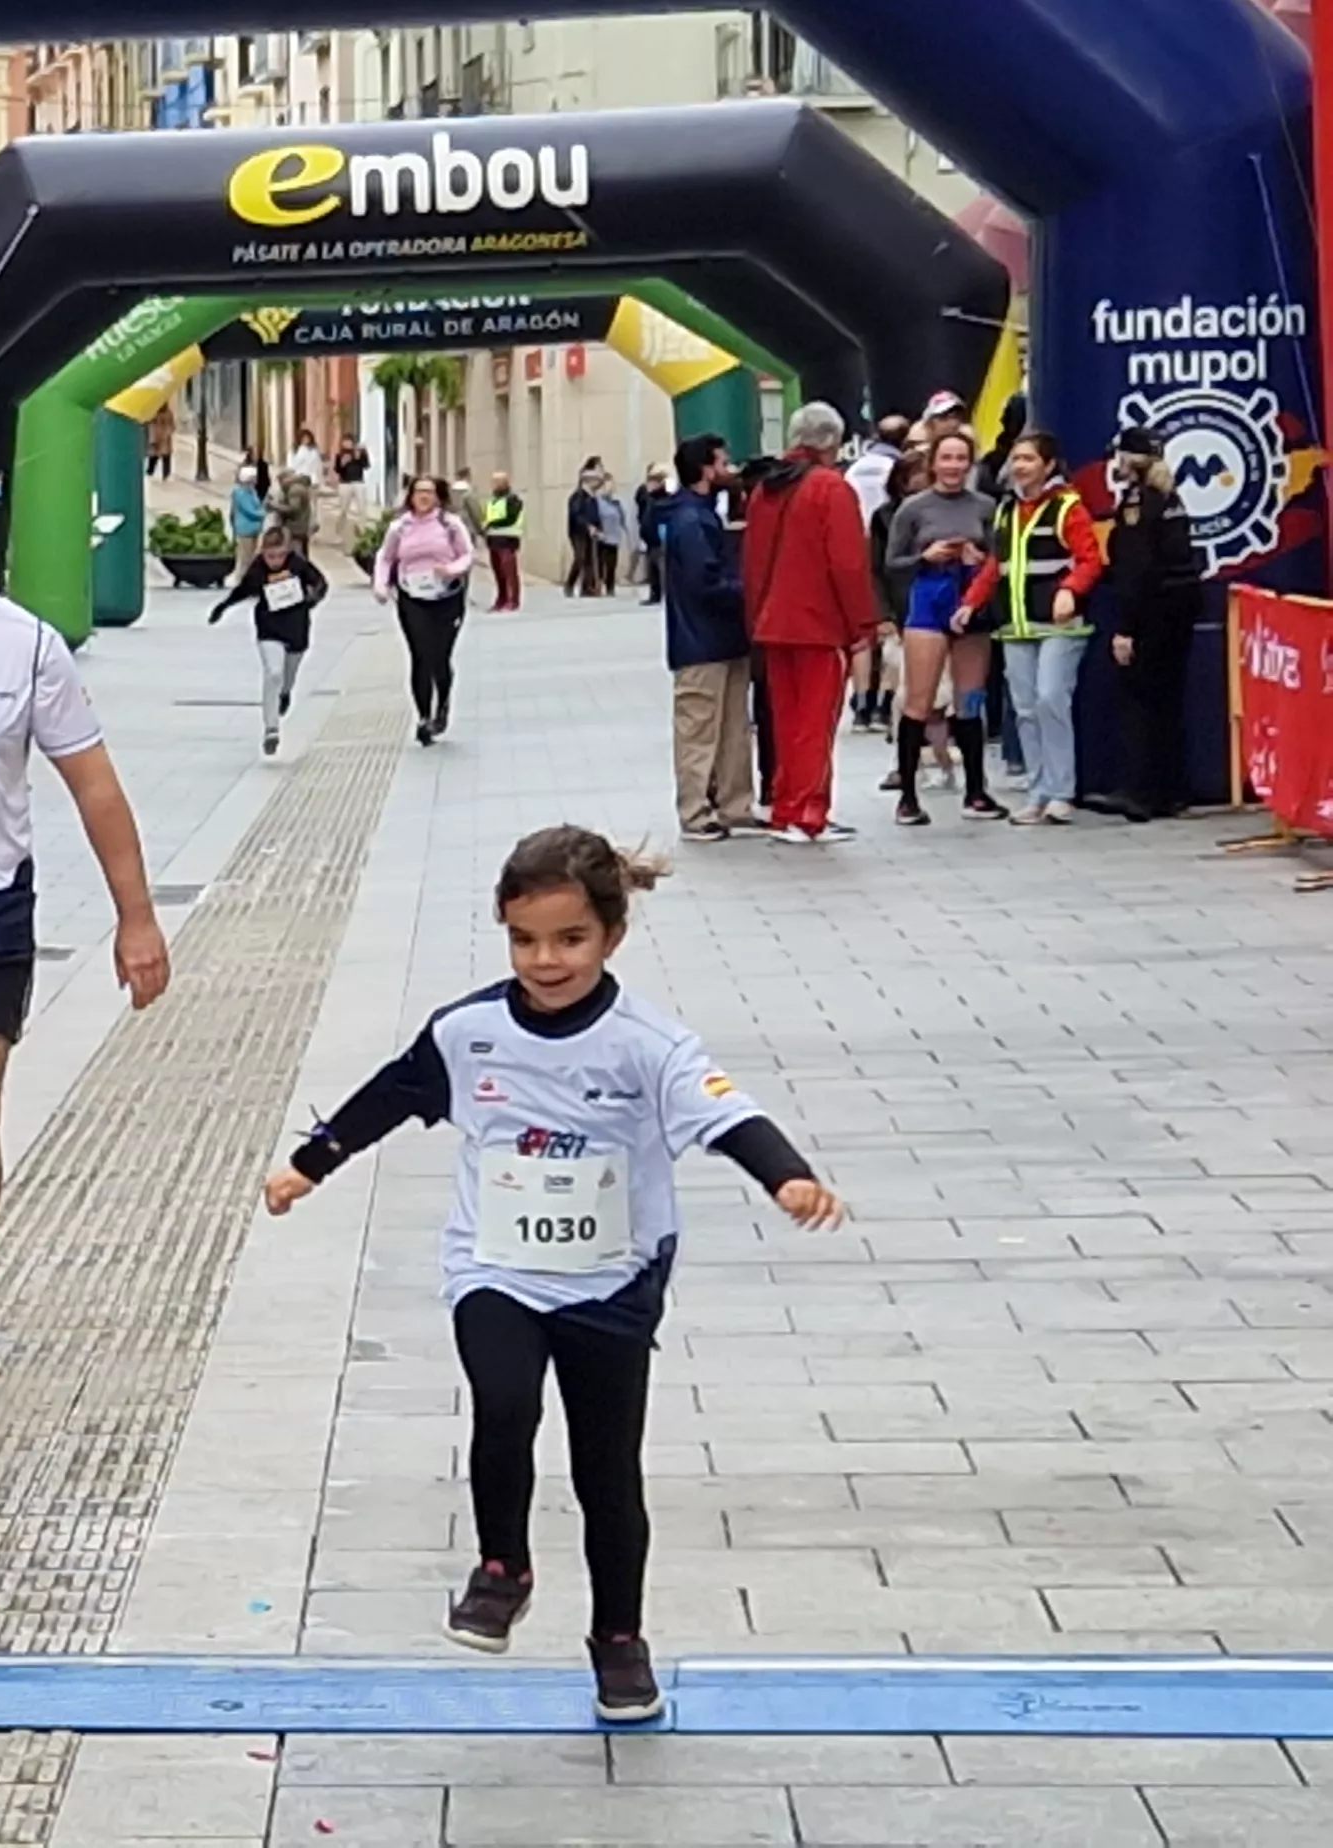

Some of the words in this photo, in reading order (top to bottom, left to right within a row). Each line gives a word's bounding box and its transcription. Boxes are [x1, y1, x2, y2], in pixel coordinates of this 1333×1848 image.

[229, 132, 589, 227] embou
[321, 242, 346, 260] LA
[348, 236, 467, 259] OPERADORA
[294, 324, 354, 344] CAJA
[362, 317, 436, 340] RURAL
[443, 317, 473, 336] DE
[482, 310, 580, 333] ARAGÓN
[1091, 293, 1306, 344] fundación
[1127, 339, 1268, 388] mupol
[515, 1215, 597, 1243] 1030
